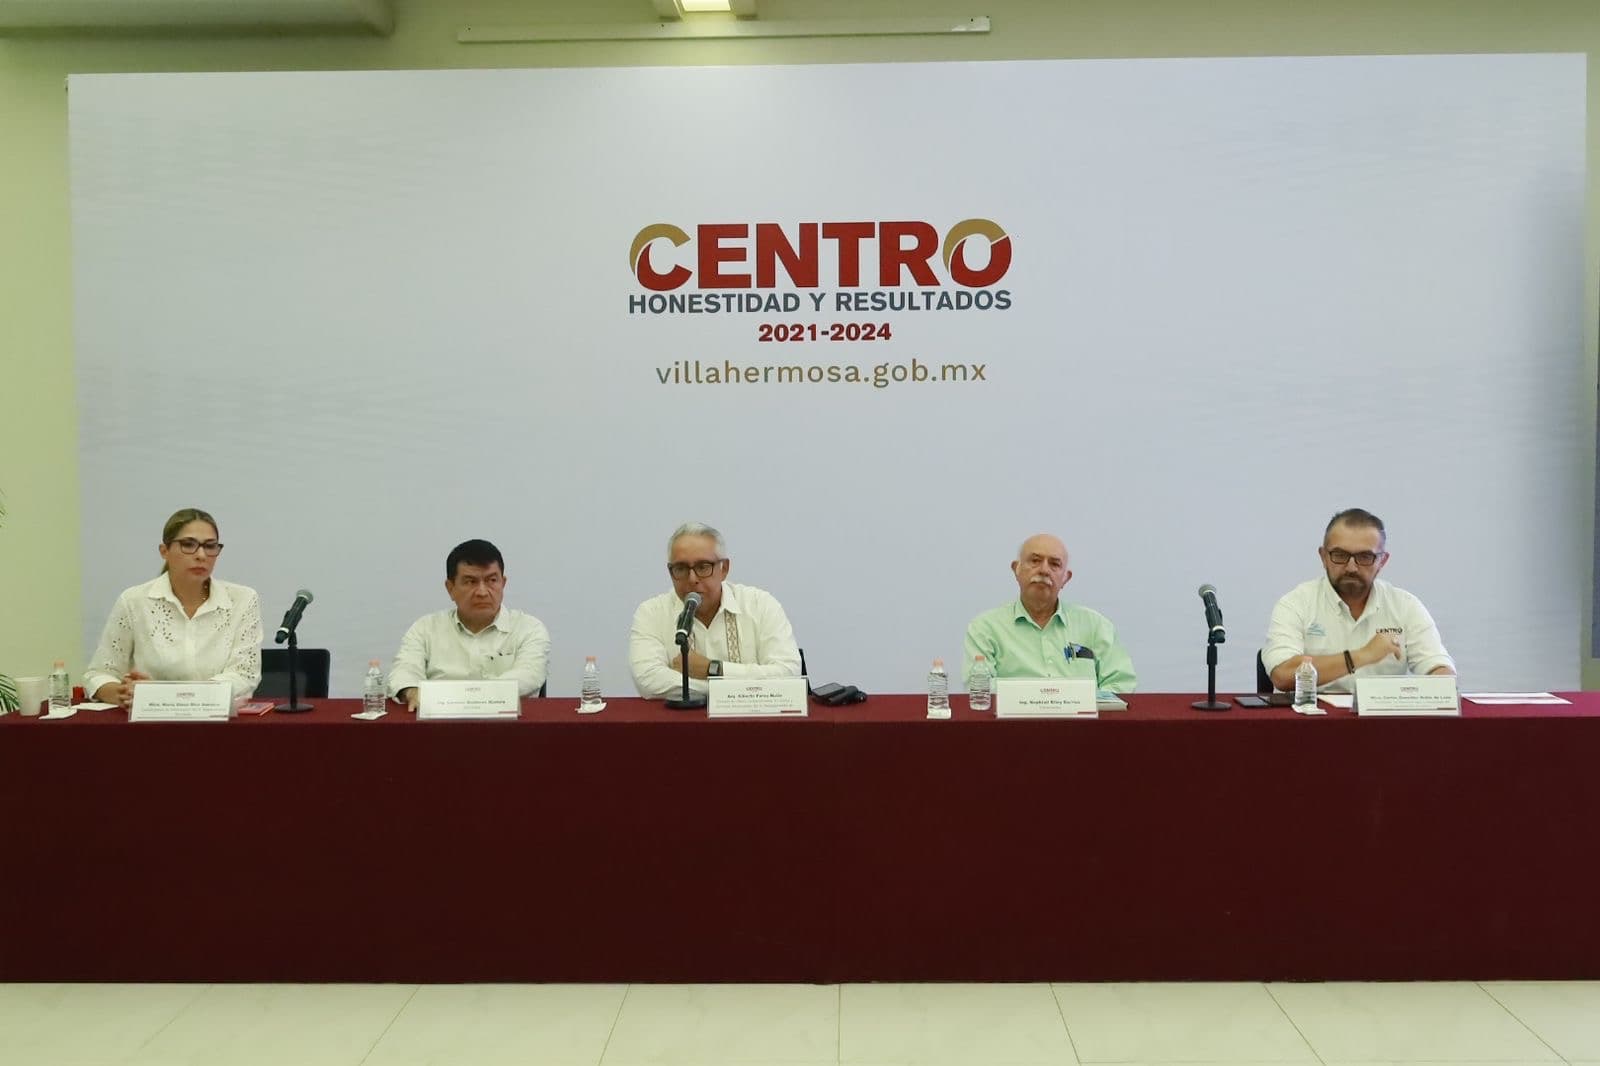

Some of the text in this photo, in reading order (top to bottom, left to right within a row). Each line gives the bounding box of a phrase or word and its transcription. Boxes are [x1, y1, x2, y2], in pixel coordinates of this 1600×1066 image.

[629, 218, 1012, 291] CENTRO
[629, 290, 1012, 314] HONESTIDAD Y RESULTADOS
[758, 323, 892, 342] 2021-2024
[656, 358, 986, 388] villahermosa.gob.mx
